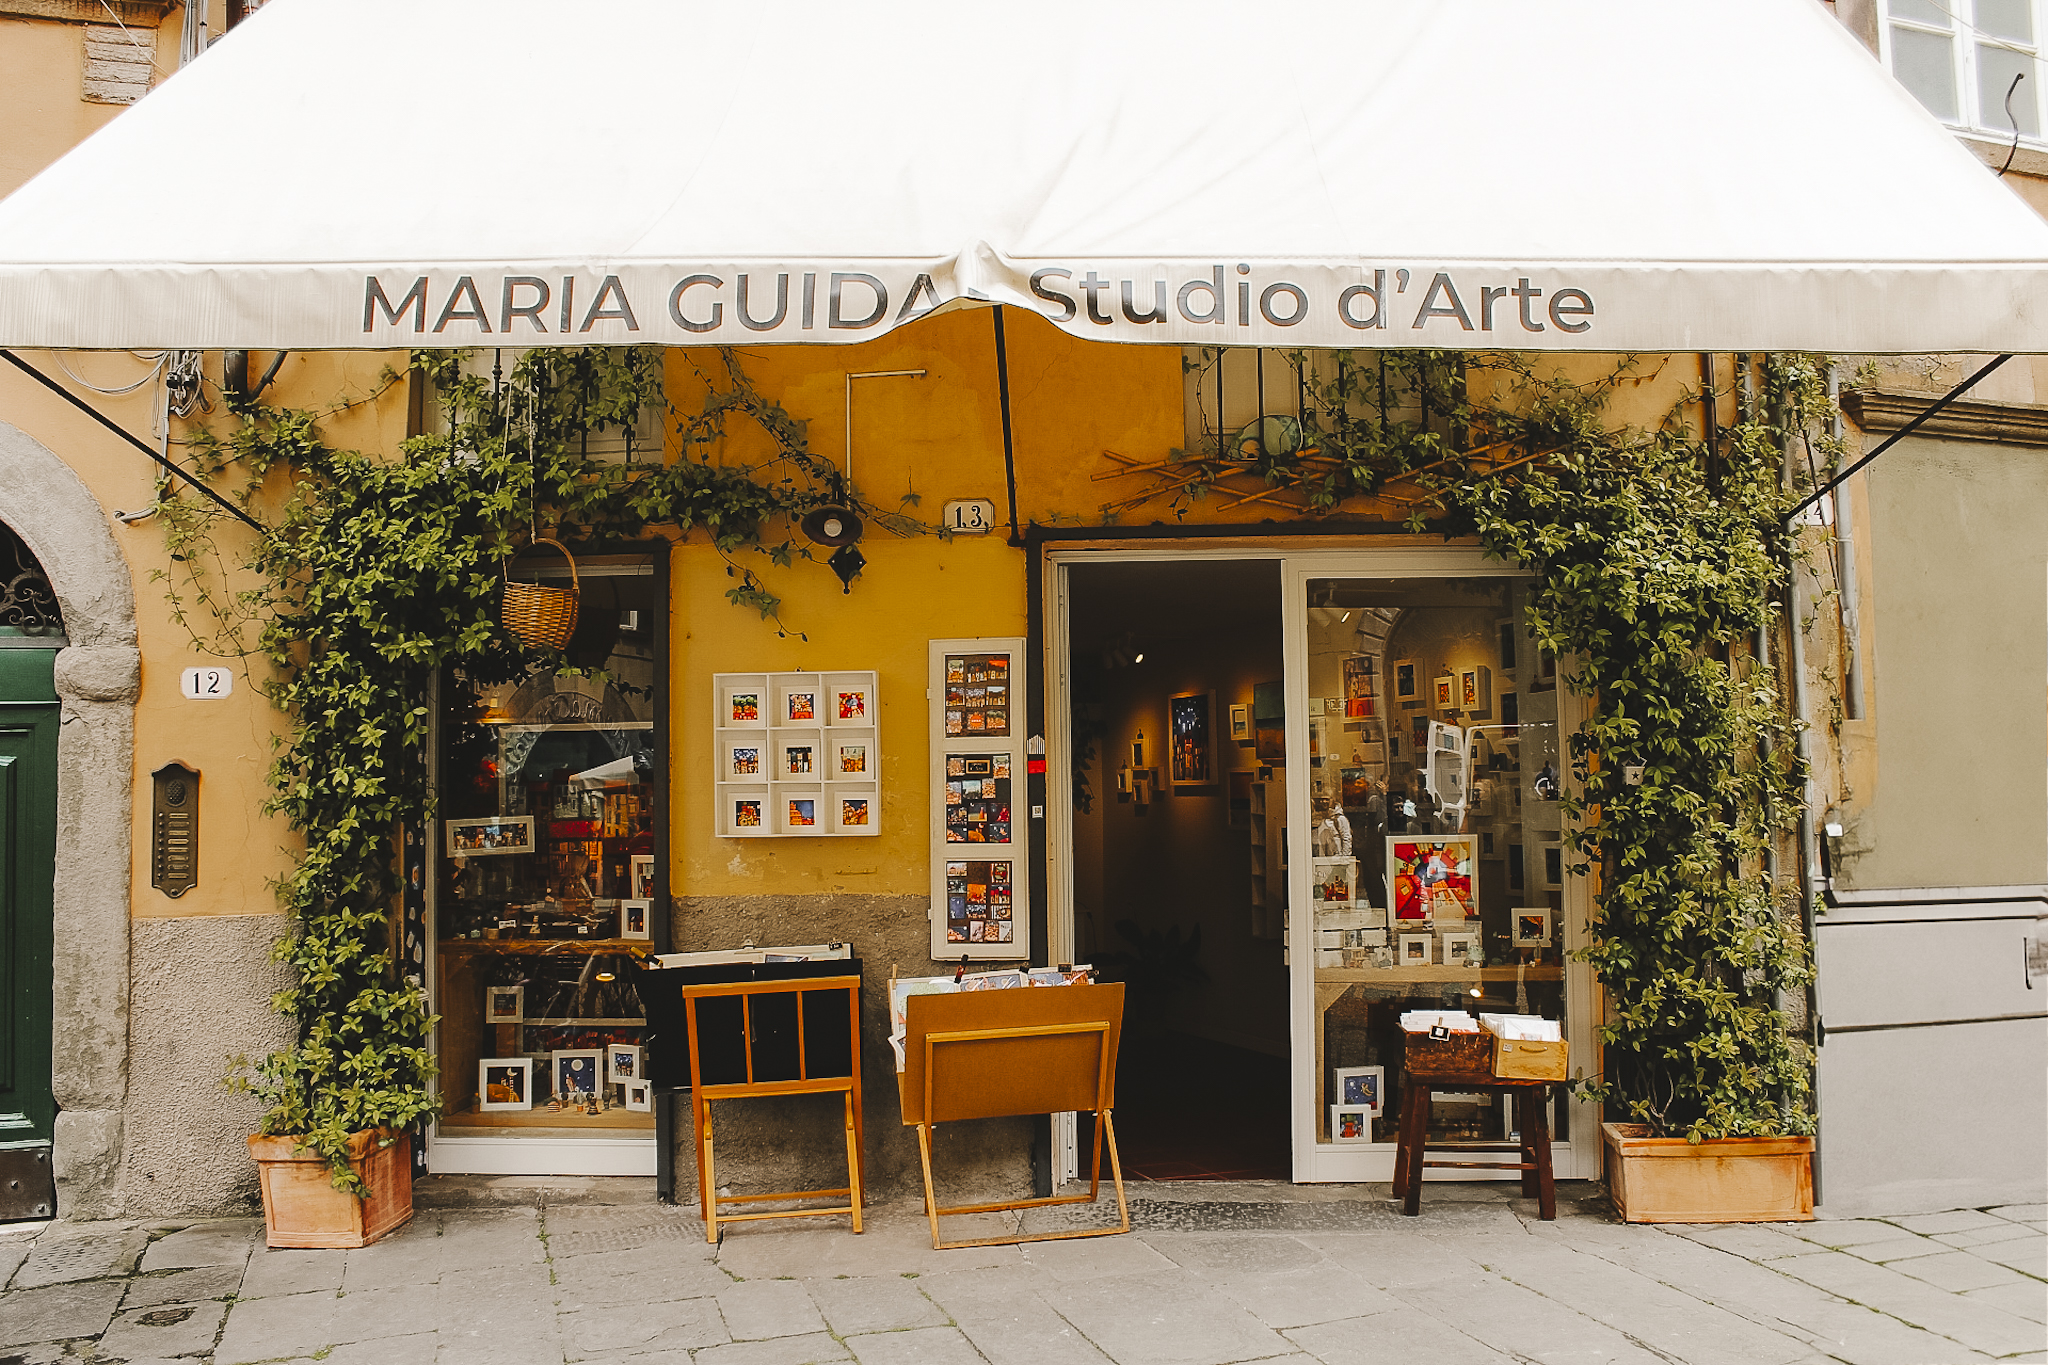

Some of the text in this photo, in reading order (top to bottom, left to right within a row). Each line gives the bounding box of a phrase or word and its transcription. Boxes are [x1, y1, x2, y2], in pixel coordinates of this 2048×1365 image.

[363, 275, 640, 334] MARIA
[669, 272, 944, 332] GUIDA
[1029, 264, 1309, 328] Studio
[956, 505, 982, 527] 13
[193, 671, 220, 694] 12
